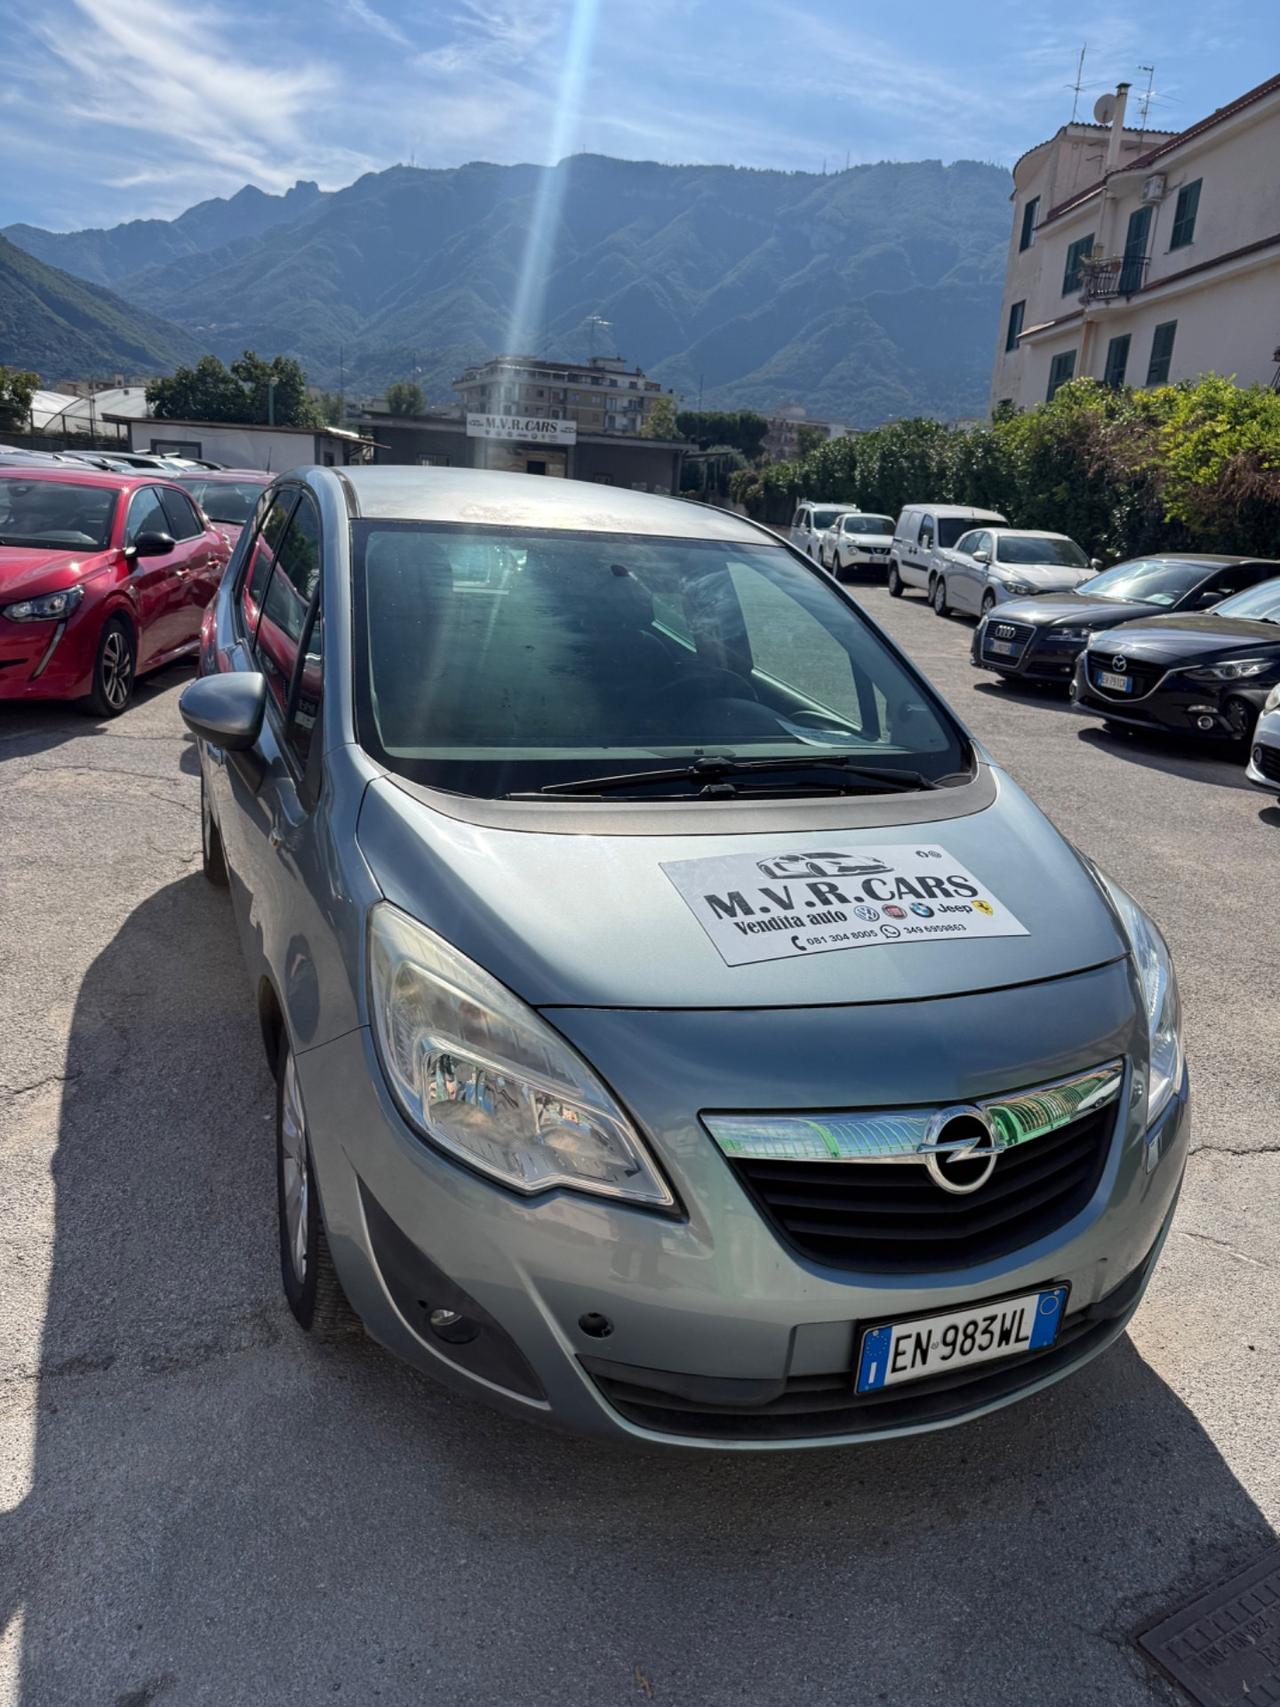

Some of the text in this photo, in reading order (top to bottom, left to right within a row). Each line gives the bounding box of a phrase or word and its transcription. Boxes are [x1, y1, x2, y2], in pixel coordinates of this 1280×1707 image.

[937, 903, 973, 917] Jeep
[734, 909, 848, 936] Vendita auto
[903, 926, 924, 934] 349
[806, 929, 878, 946] 081 304 8005
